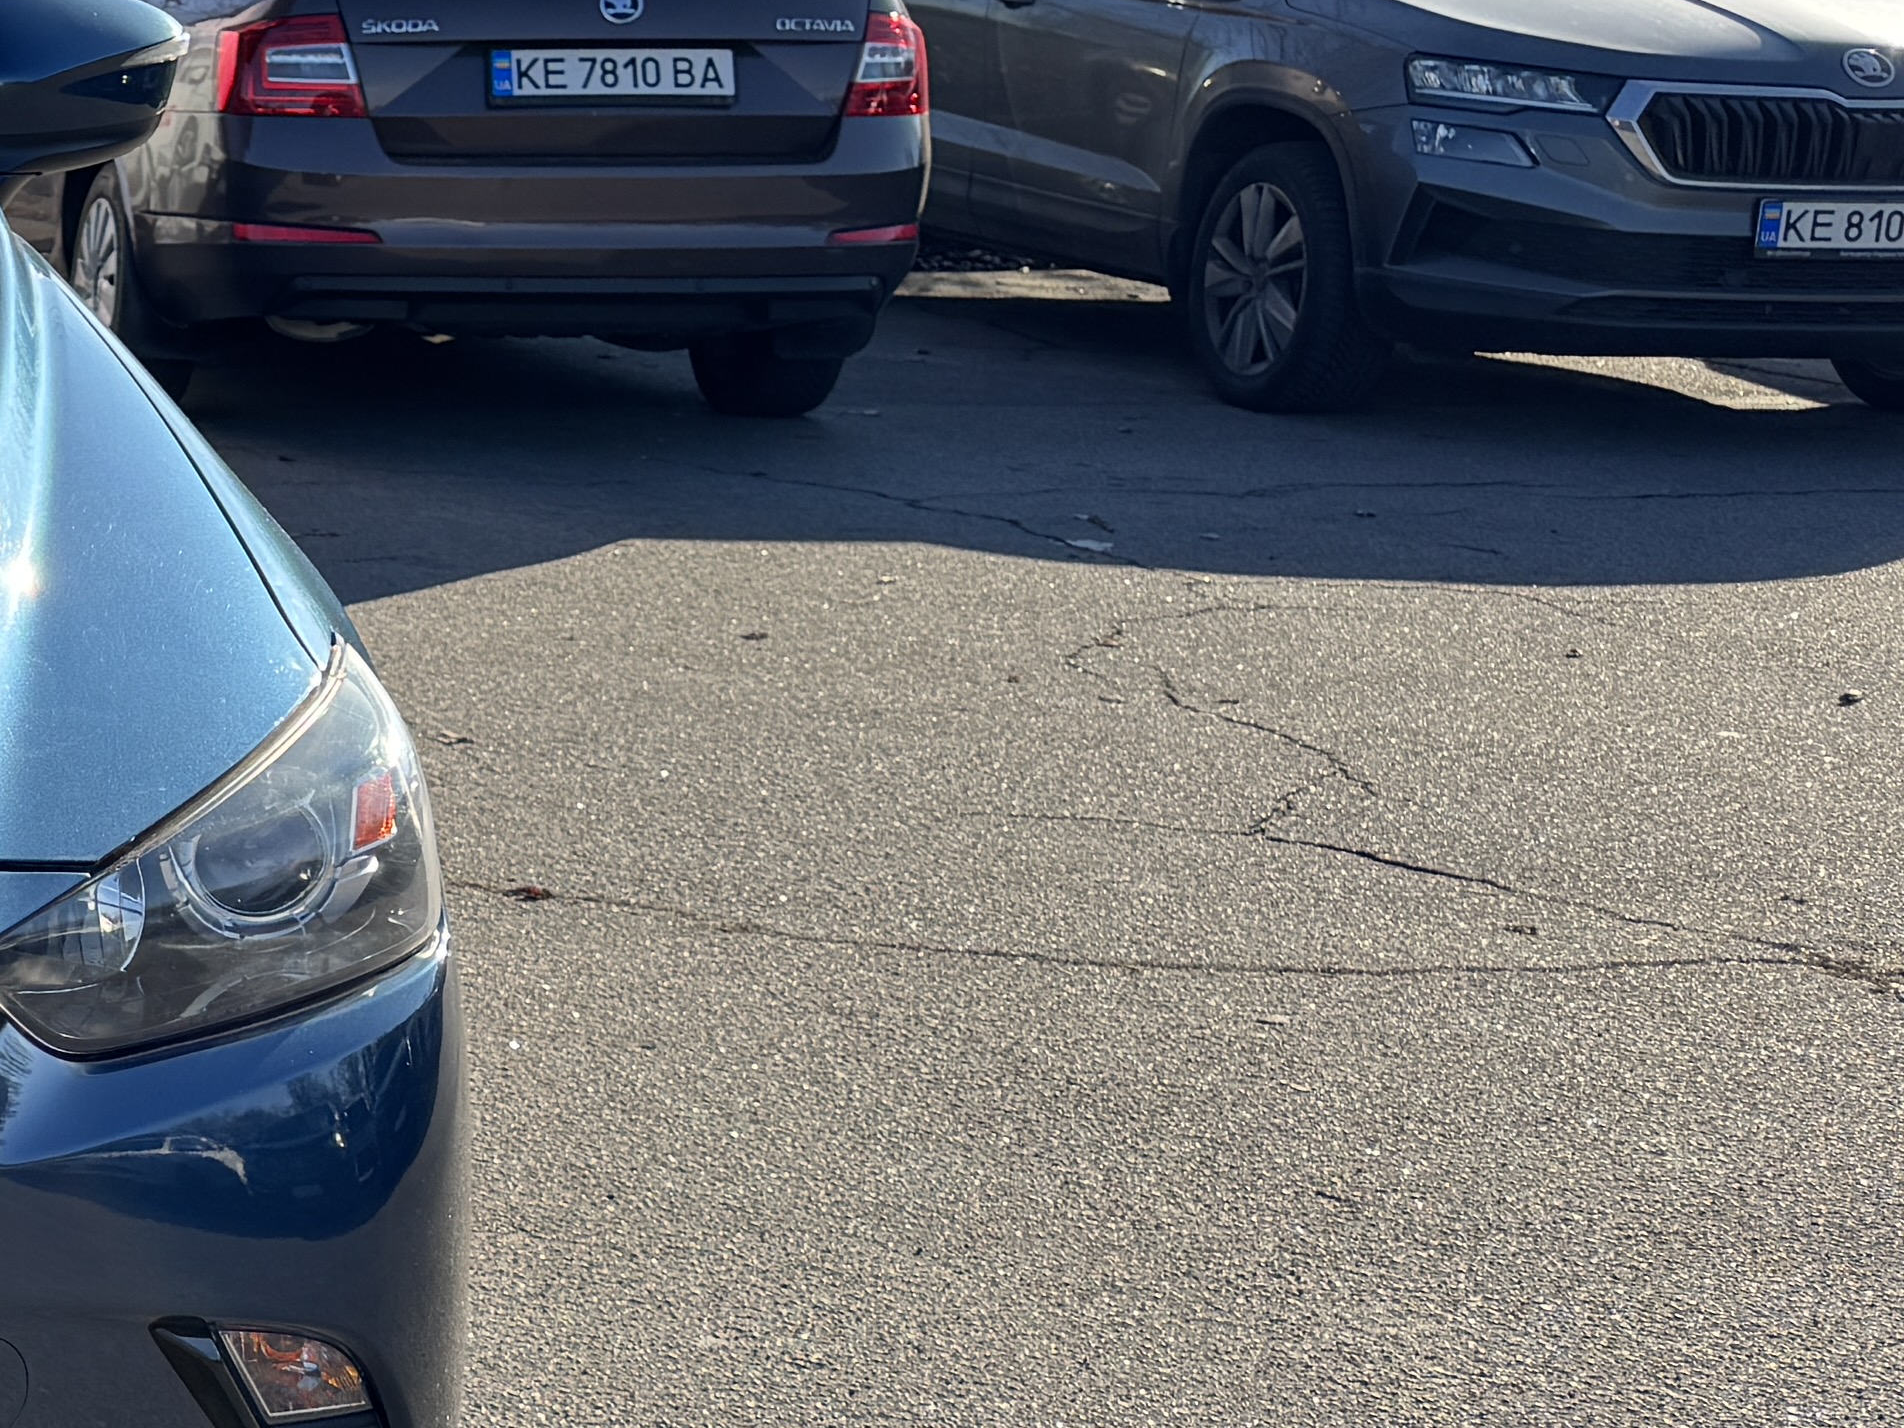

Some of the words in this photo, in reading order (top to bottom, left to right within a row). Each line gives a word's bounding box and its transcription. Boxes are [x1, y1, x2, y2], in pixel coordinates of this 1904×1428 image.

[775, 18, 856, 32] OCTAVIA
[515, 57, 568, 90] KE
[578, 56, 661, 89] 7810
[672, 56, 725, 89] BA
[1760, 231, 1777, 242] UA
[1782, 209, 1835, 243] KE
